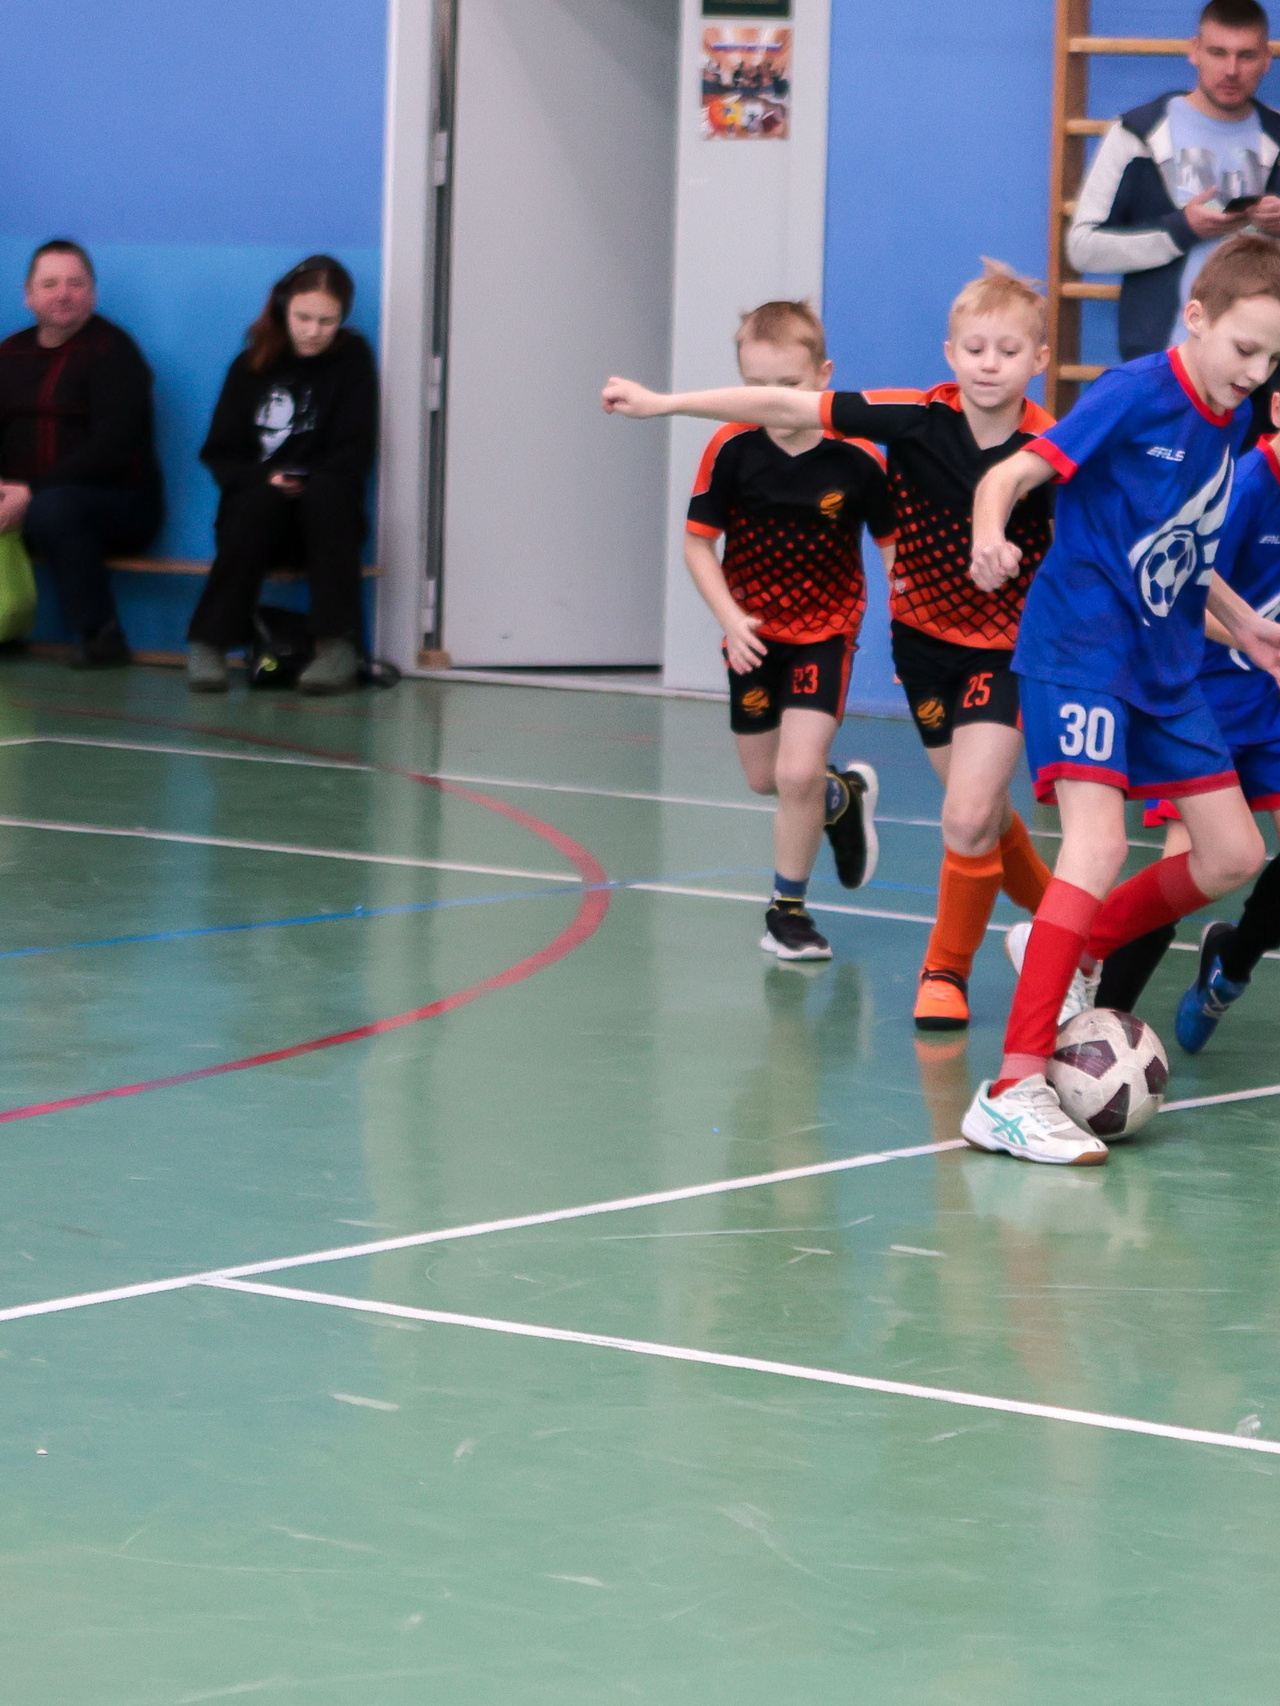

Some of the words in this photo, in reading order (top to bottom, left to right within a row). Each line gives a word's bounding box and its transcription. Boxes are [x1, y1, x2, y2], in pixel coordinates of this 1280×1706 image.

[792, 663, 818, 694] 23
[962, 672, 993, 708] 25
[1060, 703, 1115, 761] 30
